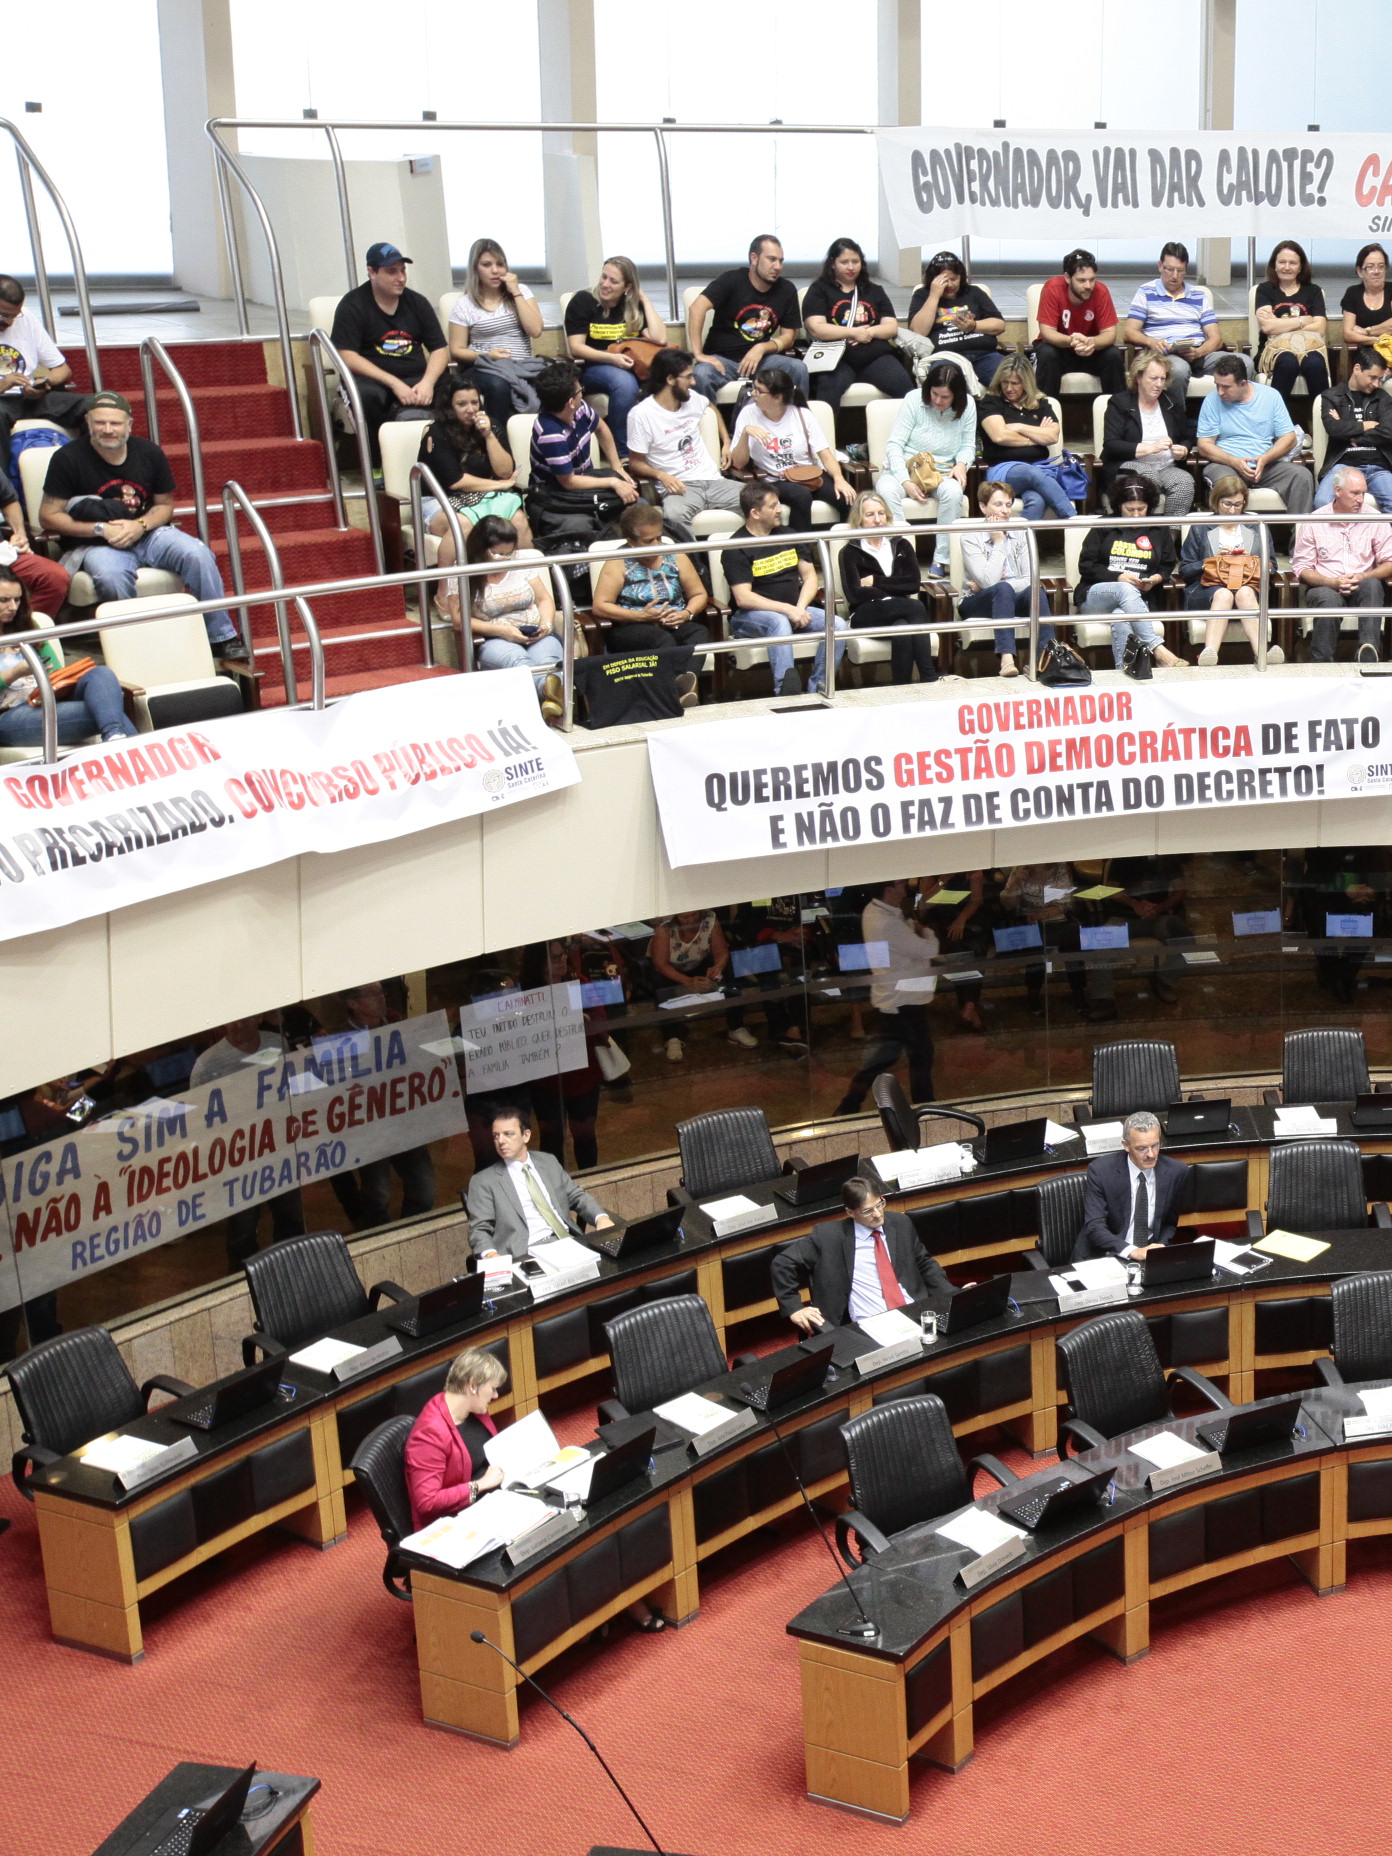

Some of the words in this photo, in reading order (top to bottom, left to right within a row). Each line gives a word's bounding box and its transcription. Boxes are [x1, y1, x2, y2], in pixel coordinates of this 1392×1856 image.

[911, 141, 1092, 218] GOVERNADOR,
[1093, 147, 1141, 209] VAI
[1148, 146, 1204, 209] DAR
[1216, 146, 1333, 209] CALOTE?
[1062, 309, 1071, 329] 9
[956, 690, 1134, 736] GOVERNADOR
[3, 731, 222, 810] GOVERNADOR
[11, 789, 235, 878] PRECARIZADO.
[374, 732, 497, 794] PÚBLICO
[490, 719, 541, 760] JÁ!
[504, 756, 544, 782] SINTE
[704, 753, 885, 813] QUEREMOS
[893, 738, 1017, 788] GESTÃO
[1024, 720, 1255, 778] DEMOCRÁTICA
[1261, 720, 1302, 758] DE
[1308, 714, 1382, 755] FATO
[768, 812, 789, 852] E
[796, 799, 861, 848] NÃO
[868, 806, 893, 842] O
[900, 795, 959, 837] FAZ
[964, 791, 1003, 831] DE
[1009, 777, 1115, 826] CONTA
[1120, 771, 1165, 811] DO
[1172, 762, 1327, 807] DECRETO!
[468, 1027, 487, 1040] TEU
[492, 1019, 518, 1035] PARTIDO
[562, 1006, 568, 1017] O
[531, 1029, 551, 1045] QUER
[468, 1068, 475, 1079] A
[482, 1059, 510, 1075] FAMÍLIA
[520, 1047, 550, 1065] TAMBÉM
[0, 1141, 81, 1206] IGA
[116, 1101, 188, 1163] SIM
[204, 1086, 229, 1130] A
[255, 1028, 407, 1110] FAMÍLIA
[13, 1192, 82, 1254] NÃO
[92, 1172, 114, 1222] À
[285, 1113, 318, 1144] DE
[71, 1208, 163, 1271] REGIÃO
[176, 1191, 207, 1228] DE
